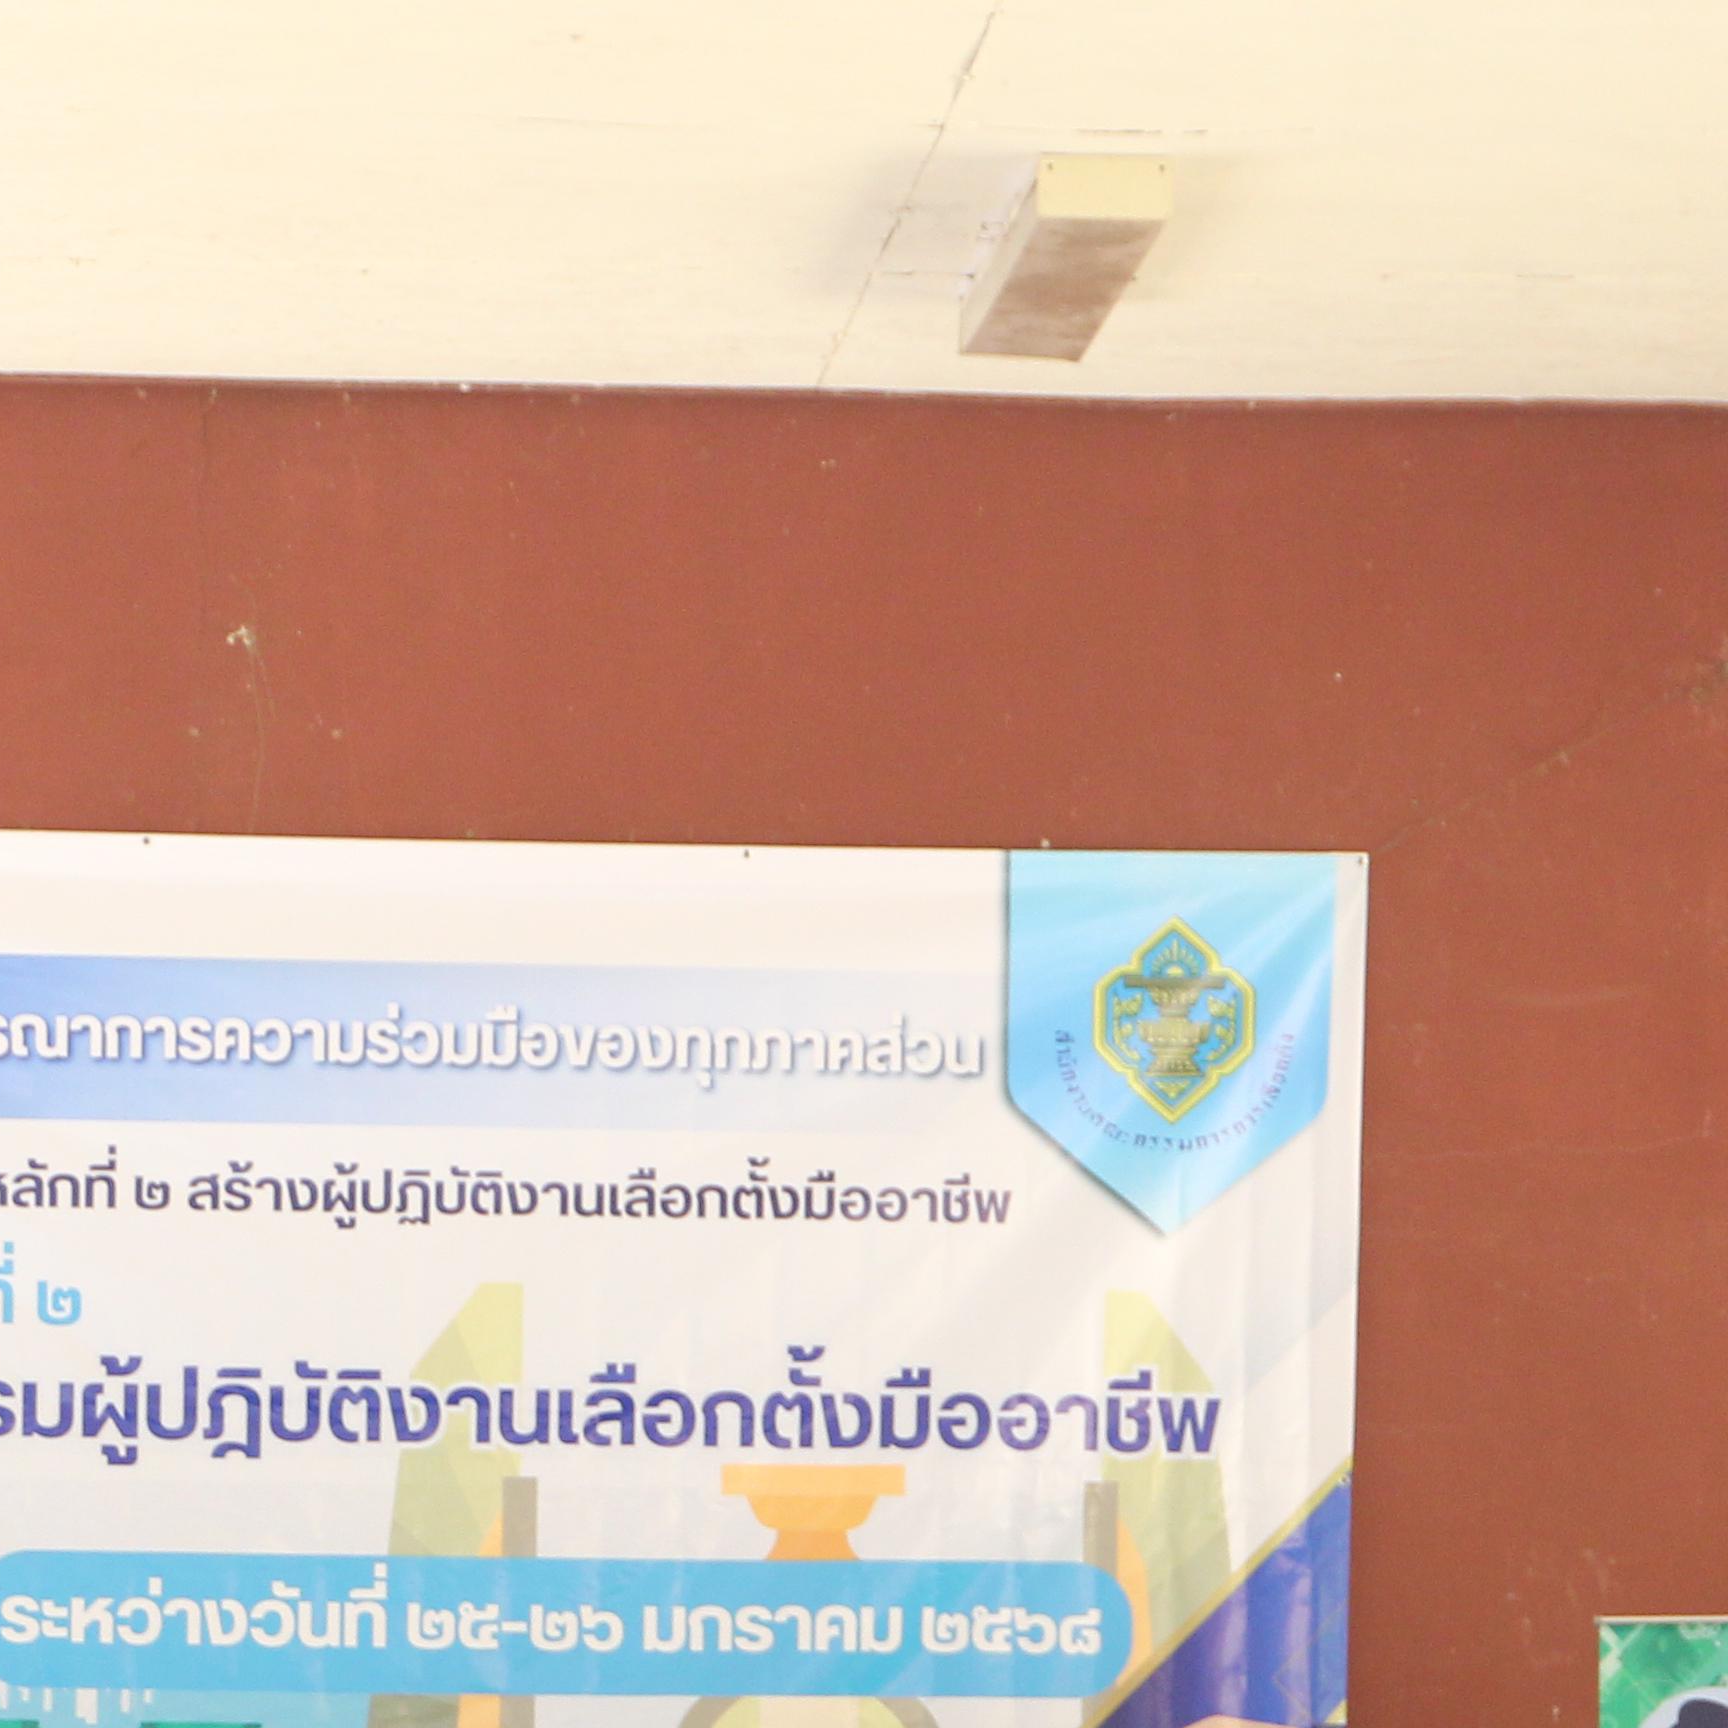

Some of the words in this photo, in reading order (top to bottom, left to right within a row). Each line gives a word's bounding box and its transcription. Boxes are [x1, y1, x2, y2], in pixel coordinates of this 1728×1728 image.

[134, 1175, 170, 1211] ๒
[187, 1158, 1012, 1229] สร้างผู้ปฏิบัติงานเลือกตั้งมืออาชีพ
[36, 1279, 82, 1325] ๒
[0, 1563, 388, 1651] ระหว่างวันที่
[406, 1600, 625, 1656] ๒๕-๒๖
[643, 1603, 903, 1655] มกราคม
[920, 1603, 1103, 1657] ๒๕๖๘
